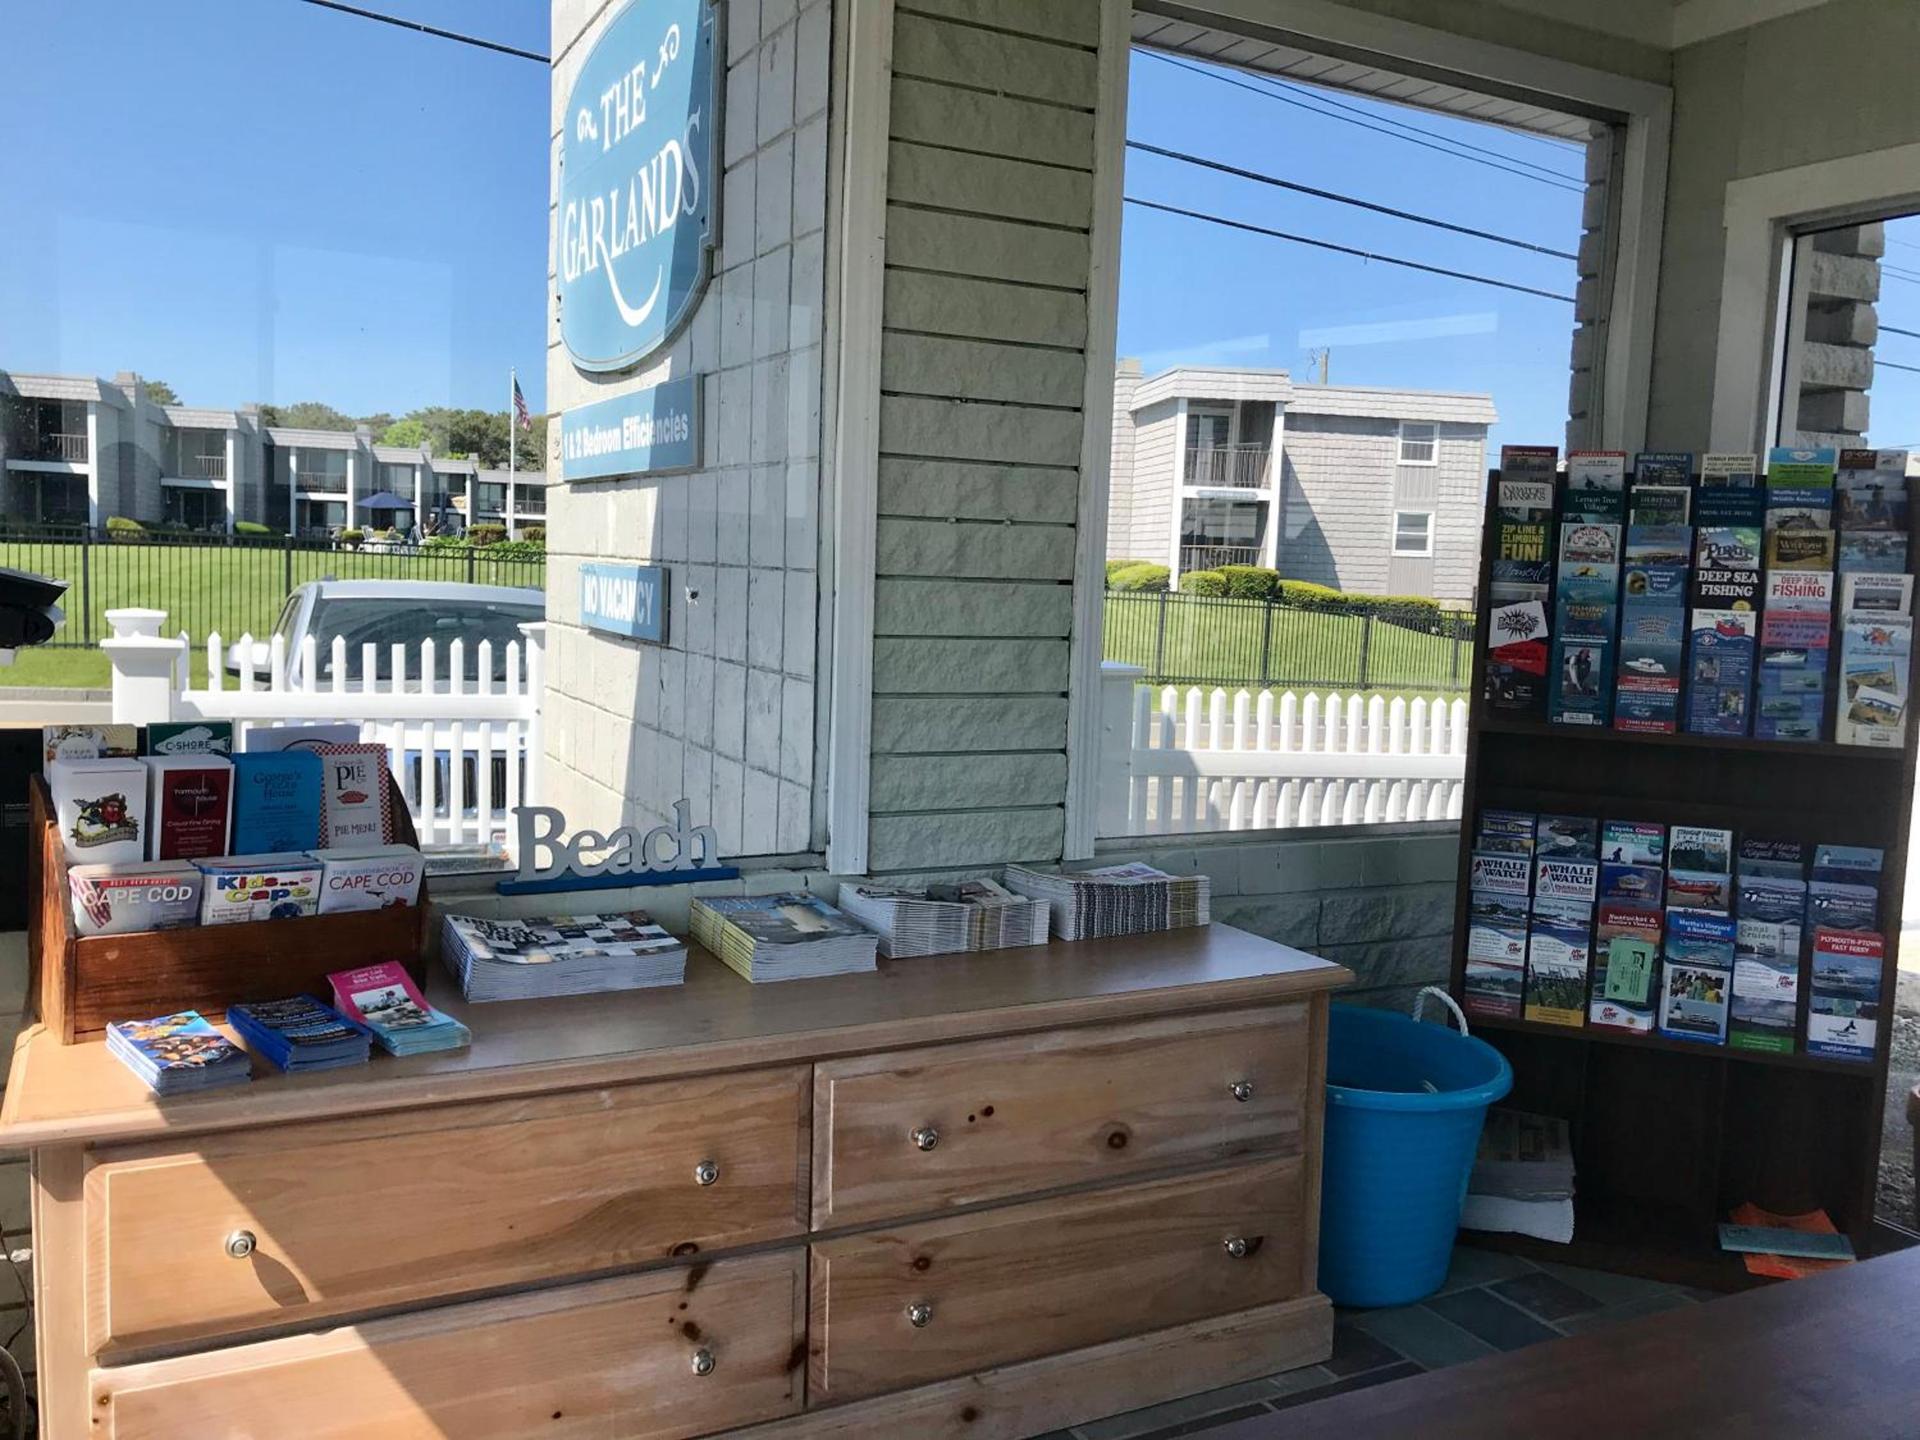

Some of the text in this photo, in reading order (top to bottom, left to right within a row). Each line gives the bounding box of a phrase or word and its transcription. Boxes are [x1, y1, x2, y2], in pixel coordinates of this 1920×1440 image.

[601, 60, 646, 151] THE
[561, 104, 701, 327] GARLANDS
[577, 428, 583, 458] 2
[583, 424, 622, 457] Bedroom
[623, 408, 689, 450] Efficiencies
[1501, 524, 1516, 534] ZIP
[1518, 525, 1538, 535] LINE
[1501, 533, 1545, 544] CLIMBING
[1501, 543, 1544, 562] FUN!
[1698, 570, 1759, 584] DEEP SEA
[1781, 576, 1820, 586] DEEP SEA
[1700, 584, 1754, 598] FISHING
[1772, 584, 1827, 598] FISHING
[584, 574, 654, 625] NO VACANCY
[334, 765, 367, 790] PIE
[334, 825, 350, 837] PIE
[511, 799, 723, 882] Beach
[1482, 859, 1527, 871] WHALE
[1548, 863, 1594, 876] WHALE
[329, 871, 415, 890] CAPE COD
[1484, 868, 1526, 879] WATCH
[1551, 873, 1593, 885] WATCH
[83, 886, 193, 906] CAPE COD
[1831, 943, 1848, 952] FAST
